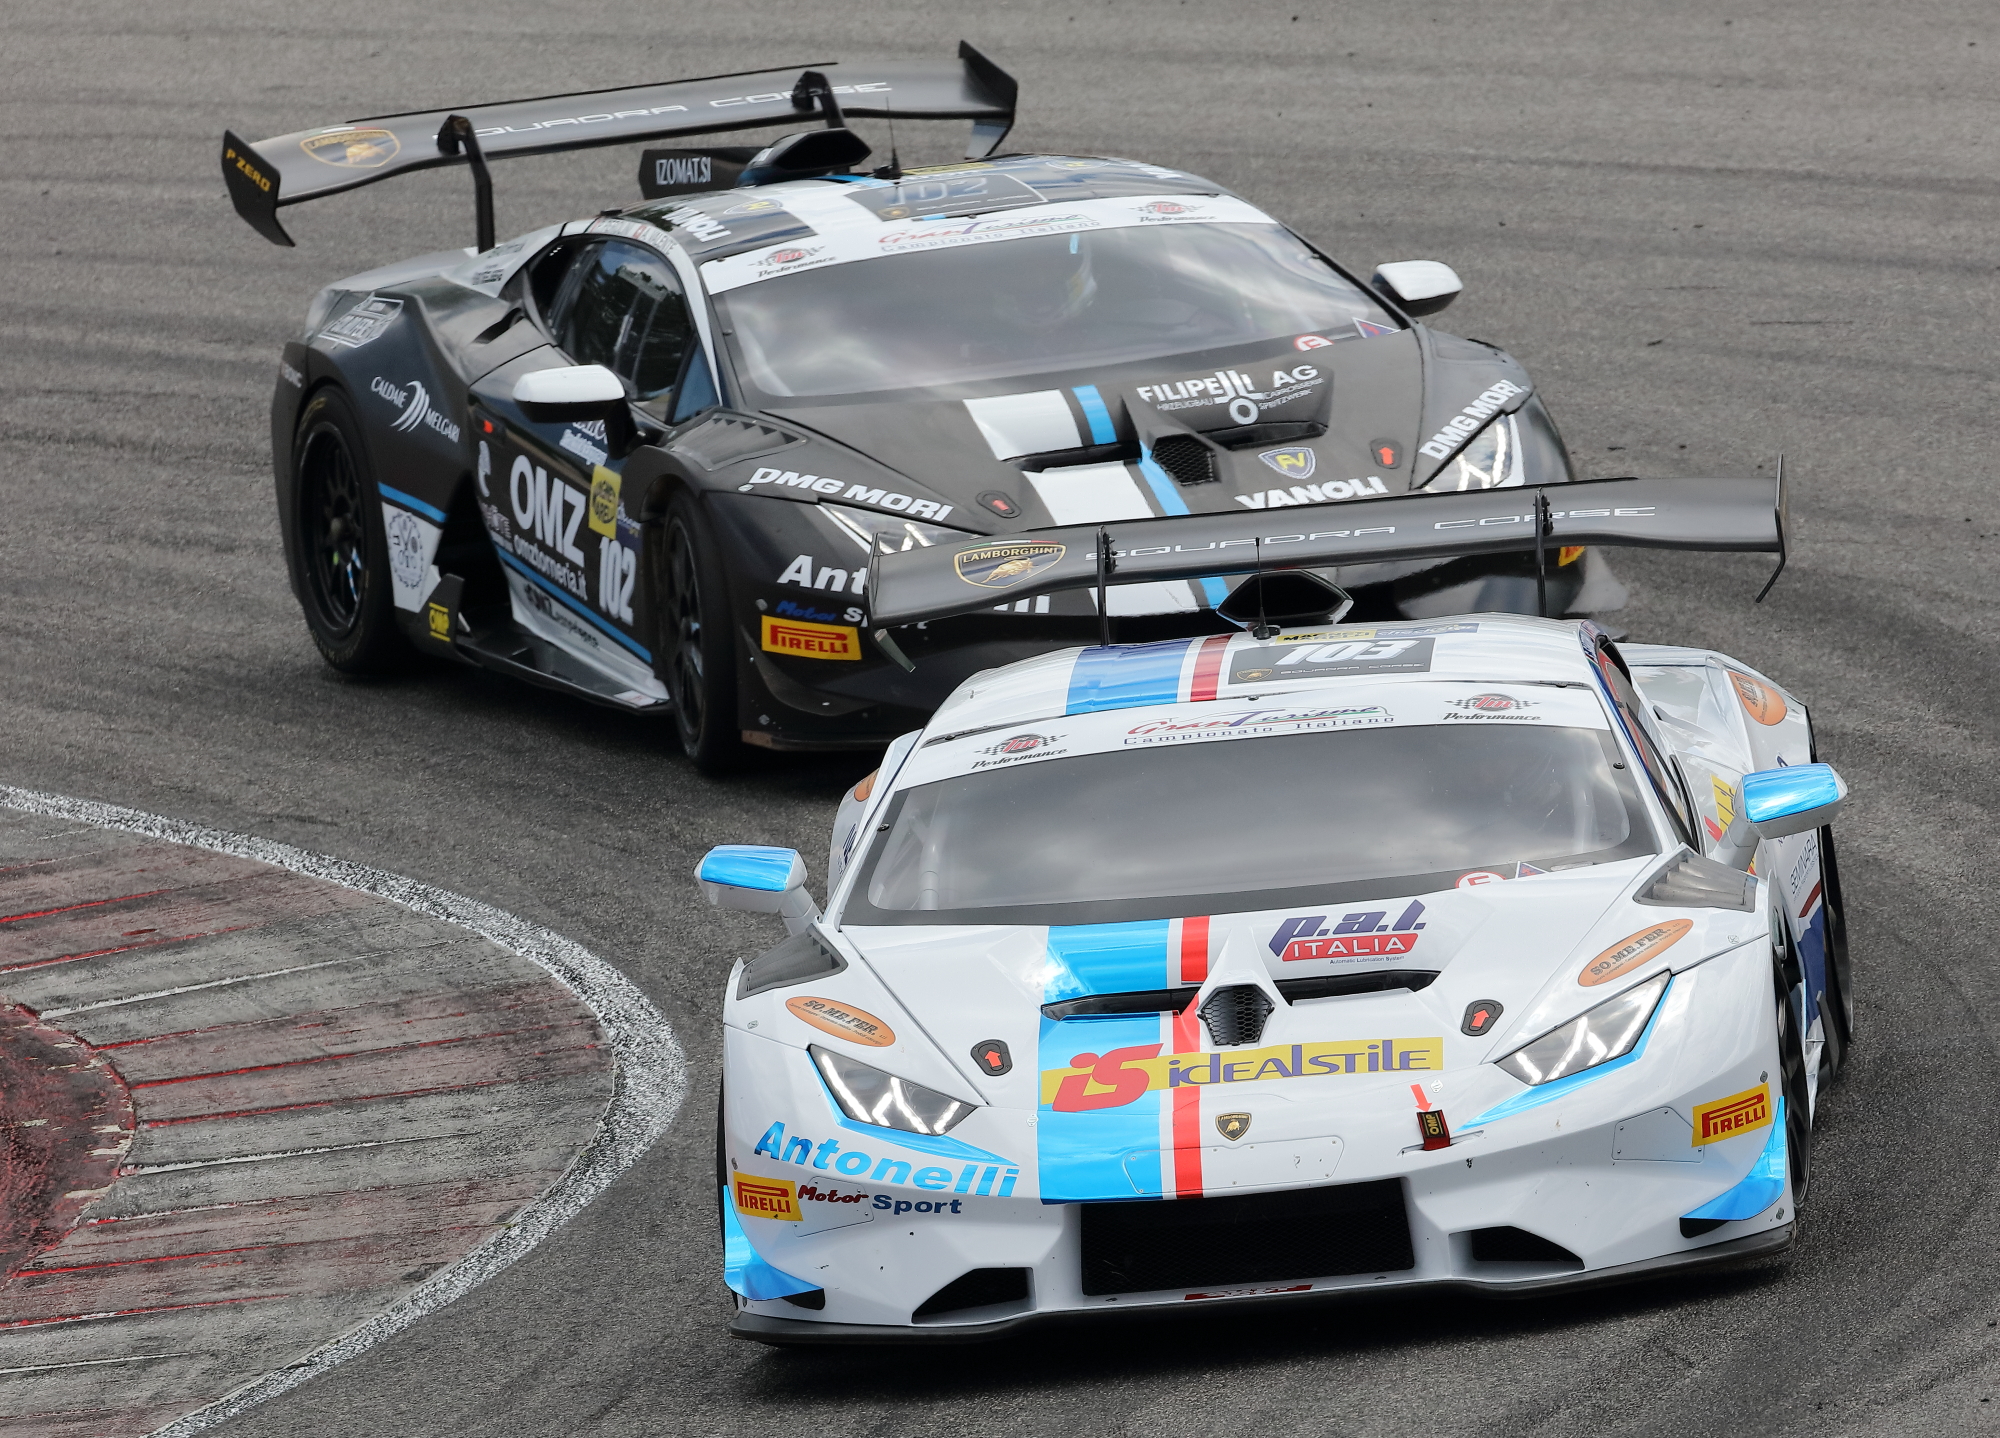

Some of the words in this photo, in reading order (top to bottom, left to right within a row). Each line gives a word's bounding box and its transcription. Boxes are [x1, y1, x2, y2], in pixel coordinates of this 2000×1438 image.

[432, 104, 689, 141] QUADRA
[226, 148, 236, 159] P
[236, 156, 272, 192] ZERO
[1273, 365, 1319, 388] AG
[424, 407, 461, 443] MELGARI
[1419, 415, 1480, 461] DMG
[1462, 379, 1524, 420] MORI
[749, 467, 846, 495] DMG
[846, 484, 954, 522] MORI
[1234, 475, 1389, 509] VANOLI
[510, 454, 587, 568] OMZ
[963, 547, 1059, 564] LAMBORGHINI
[599, 536, 637, 627] 102
[776, 600, 838, 621] Motor
[769, 624, 849, 654] PIRELLI
[1274, 640, 1421, 666] 103
[1123, 727, 1273, 745] Campionato
[1296, 717, 1395, 730] Italiano
[1442, 712, 1542, 721] Performance
[970, 748, 1068, 770] Performance
[1293, 936, 1406, 958] ITALIA
[1425, 1114, 1440, 1135] OMP
[1701, 1092, 1766, 1139] PIRELLI
[753, 1120, 1020, 1198] Antonelli
[737, 1181, 792, 1214] PIRELLI
[797, 1184, 869, 1205] Motor
[871, 1193, 963, 1216] Sport
